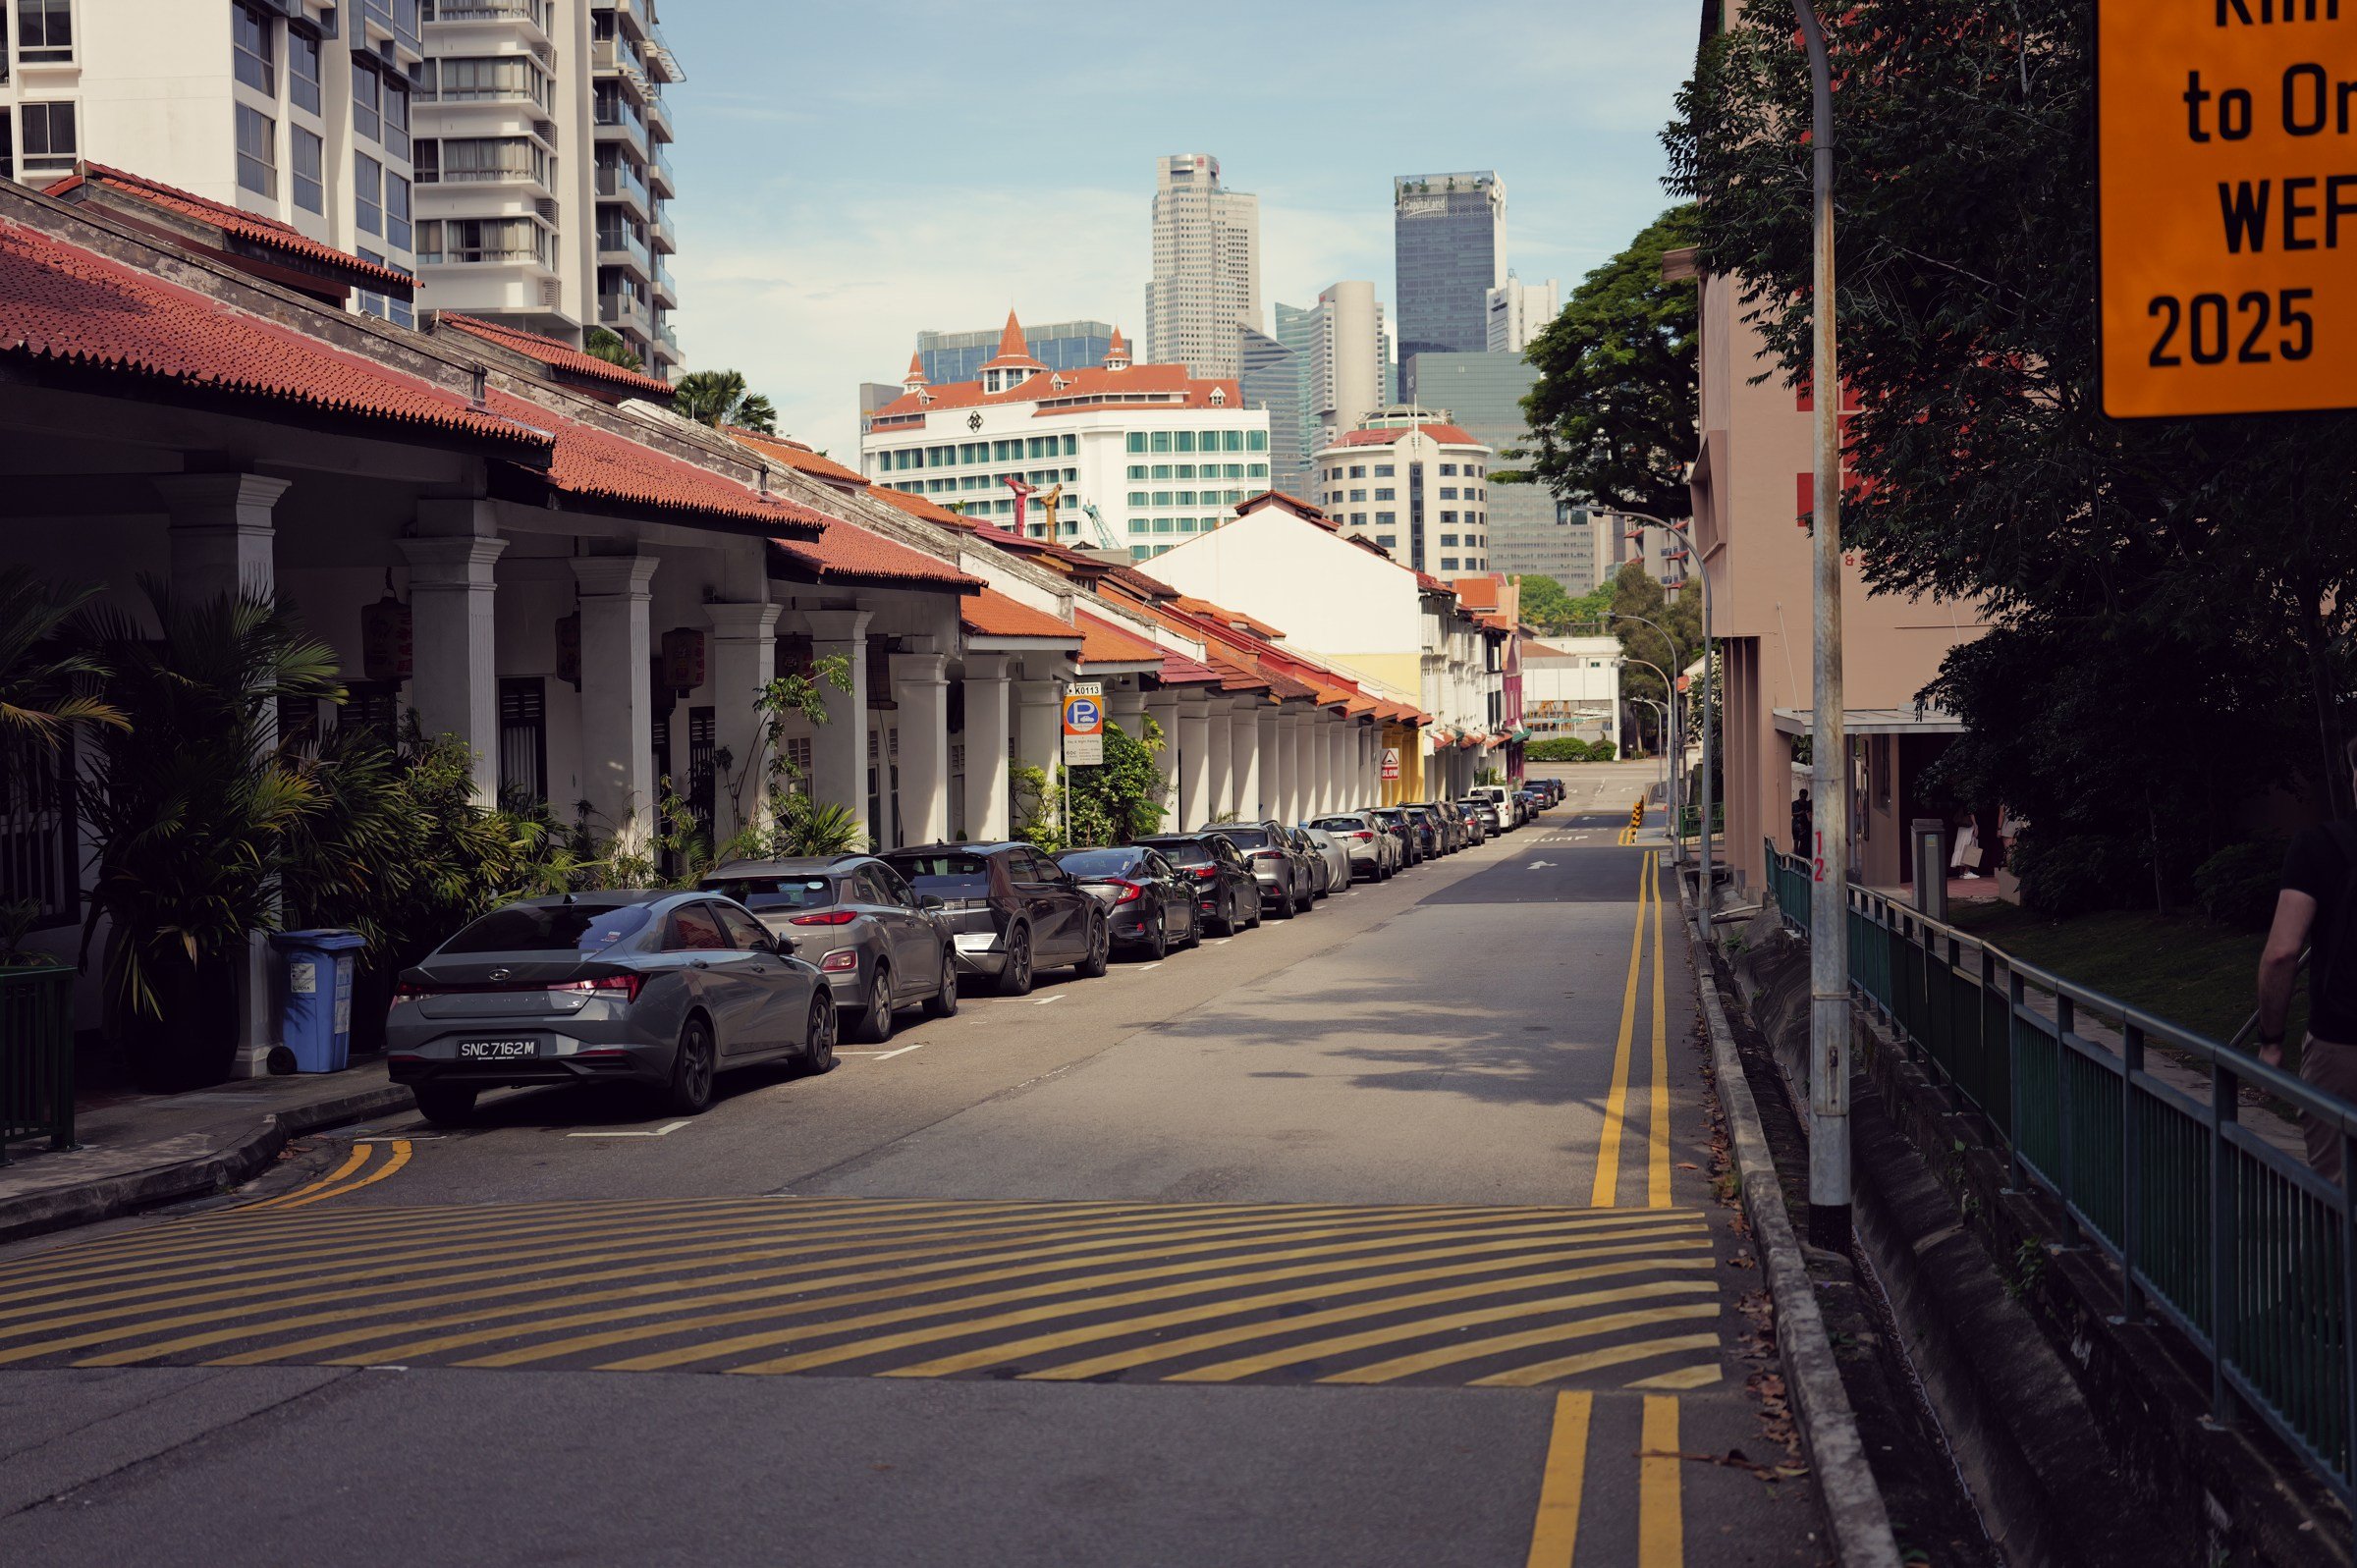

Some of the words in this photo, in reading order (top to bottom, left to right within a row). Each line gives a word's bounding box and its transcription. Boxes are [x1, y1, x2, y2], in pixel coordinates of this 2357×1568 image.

[2182, 70, 2253, 143] to
[1403, 198, 1446, 212] CapitaLand
[2218, 175, 2357, 254] WEF
[2147, 289, 2315, 367] 2025
[1073, 701, 1095, 724] P
[1523, 835, 1589, 843] HUMP
[461, 1043, 490, 1056] SNC
[492, 1041, 535, 1055] 7162M
